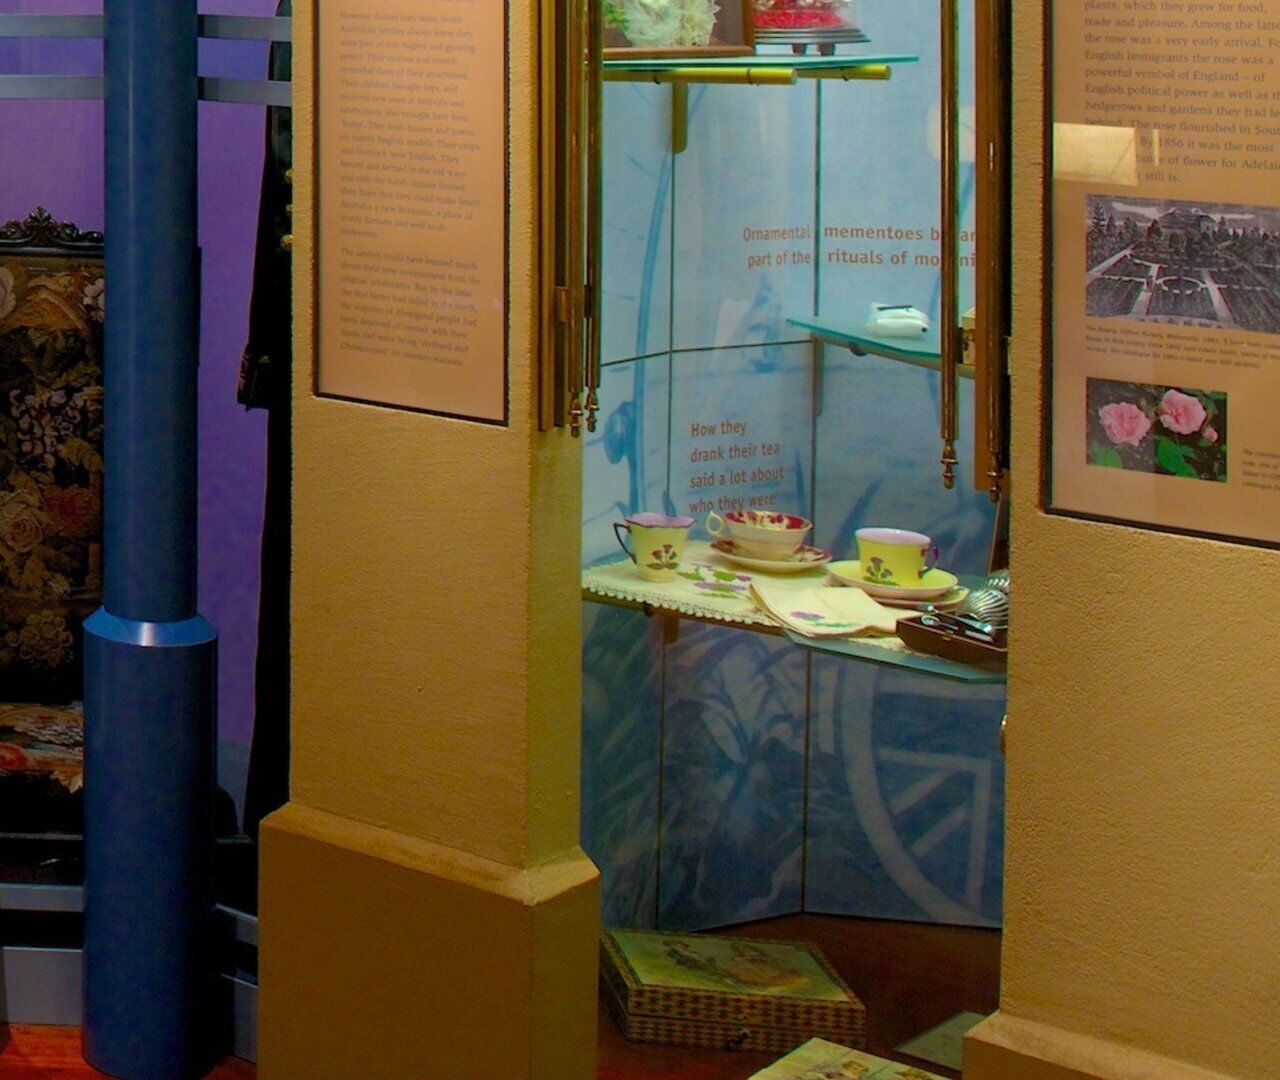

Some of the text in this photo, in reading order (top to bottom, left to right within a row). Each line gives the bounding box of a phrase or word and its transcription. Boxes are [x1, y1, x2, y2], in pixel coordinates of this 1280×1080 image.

[1123, 1, 1157, 11] which
[1160, 1, 1183, 15] they
[1218, 2, 1233, 12] for
[743, 226, 811, 242] Ornamental
[824, 226, 923, 241] mementoes
[747, 253, 772, 269] part
[776, 252, 788, 265] of
[792, 251, 810, 264] the
[828, 250, 884, 265] rituals
[890, 251, 908, 265] of
[691, 420, 746, 438] How they
[690, 443, 781, 463] drank their tea
[690, 466, 785, 488] said a lot about
[690, 493, 776, 513] who they were
